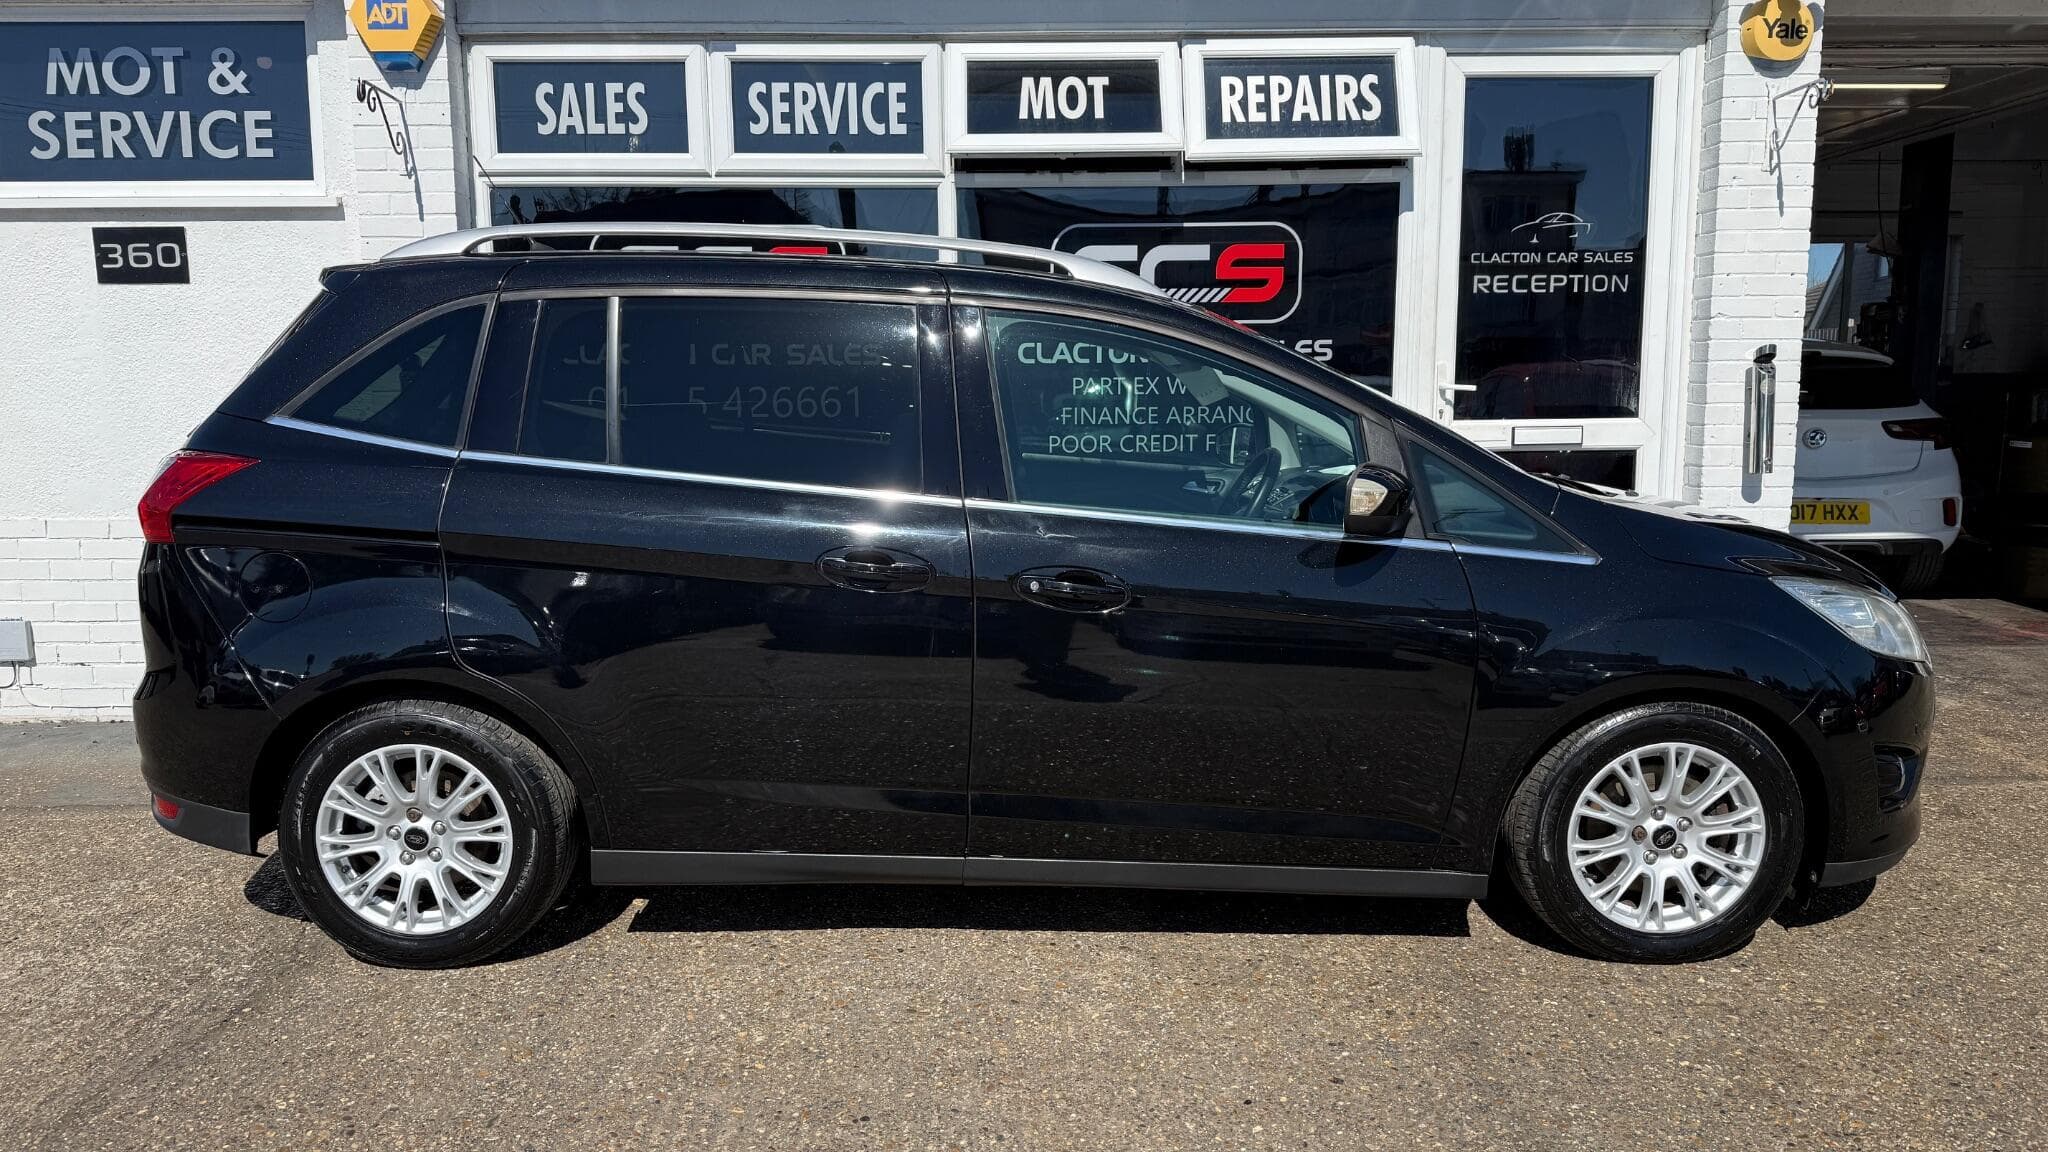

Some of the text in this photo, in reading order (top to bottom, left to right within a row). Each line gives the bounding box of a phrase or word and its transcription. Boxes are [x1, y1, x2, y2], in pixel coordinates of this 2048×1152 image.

[367, 3, 407, 25] ADT
[1762, 18, 1808, 39] Yale
[46, 47, 250, 95] MOT &
[535, 82, 648, 136] SALES
[748, 82, 907, 135] SERVICE
[1018, 76, 1109, 120] MOT
[1220, 73, 1382, 123] REPAIRS
[28, 110, 274, 159] SERVICE
[100, 243, 181, 268] 360
[1471, 252, 1634, 264] CLACTON CAR SALES
[1473, 274, 1629, 293] RECEPTION
[787, 343, 880, 366] SALES
[1072, 376, 1125, 396] PART
[1134, 376, 1160, 395] EX
[722, 386, 860, 418] 426661
[1062, 407, 1159, 425] FINANCE
[1049, 435, 1112, 453] POOR
[1119, 434, 1198, 453] CREDIT
[1823, 504, 1859, 520] HXX
